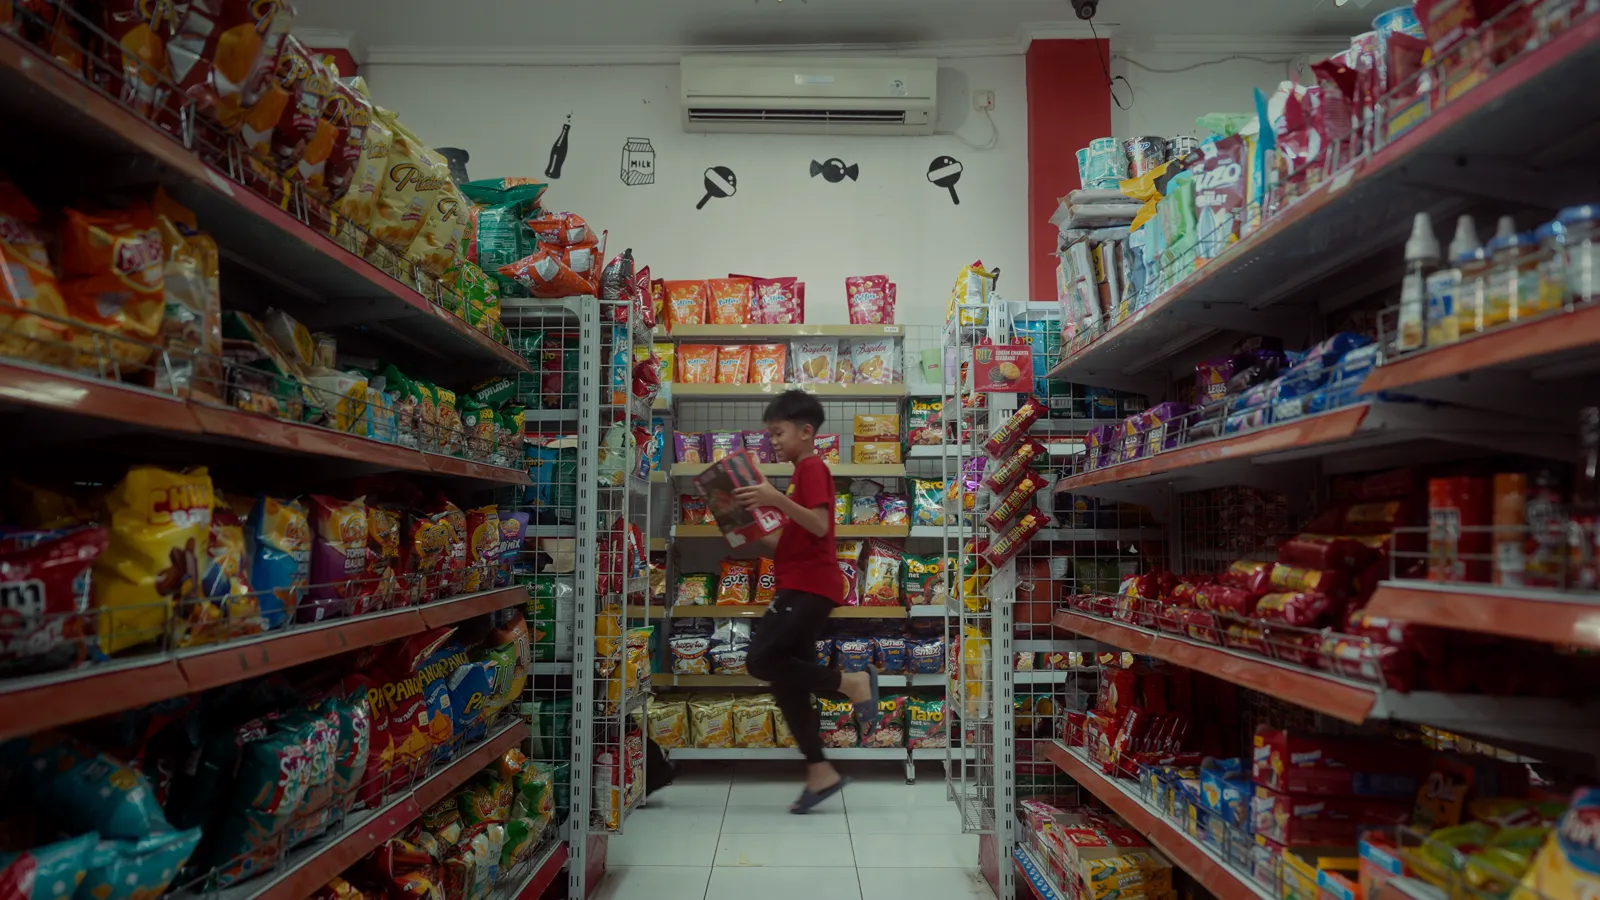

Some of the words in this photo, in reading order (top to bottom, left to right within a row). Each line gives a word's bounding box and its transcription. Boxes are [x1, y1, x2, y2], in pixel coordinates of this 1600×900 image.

[631, 159, 652, 168] MILK
[976, 349, 993, 361] RITZ
[992, 427, 1010, 444] RITZ
[993, 502, 1013, 521] RITZ
[994, 536, 1013, 555] RITZ
[908, 559, 940, 575] Taro
[908, 706, 944, 721] Taro
